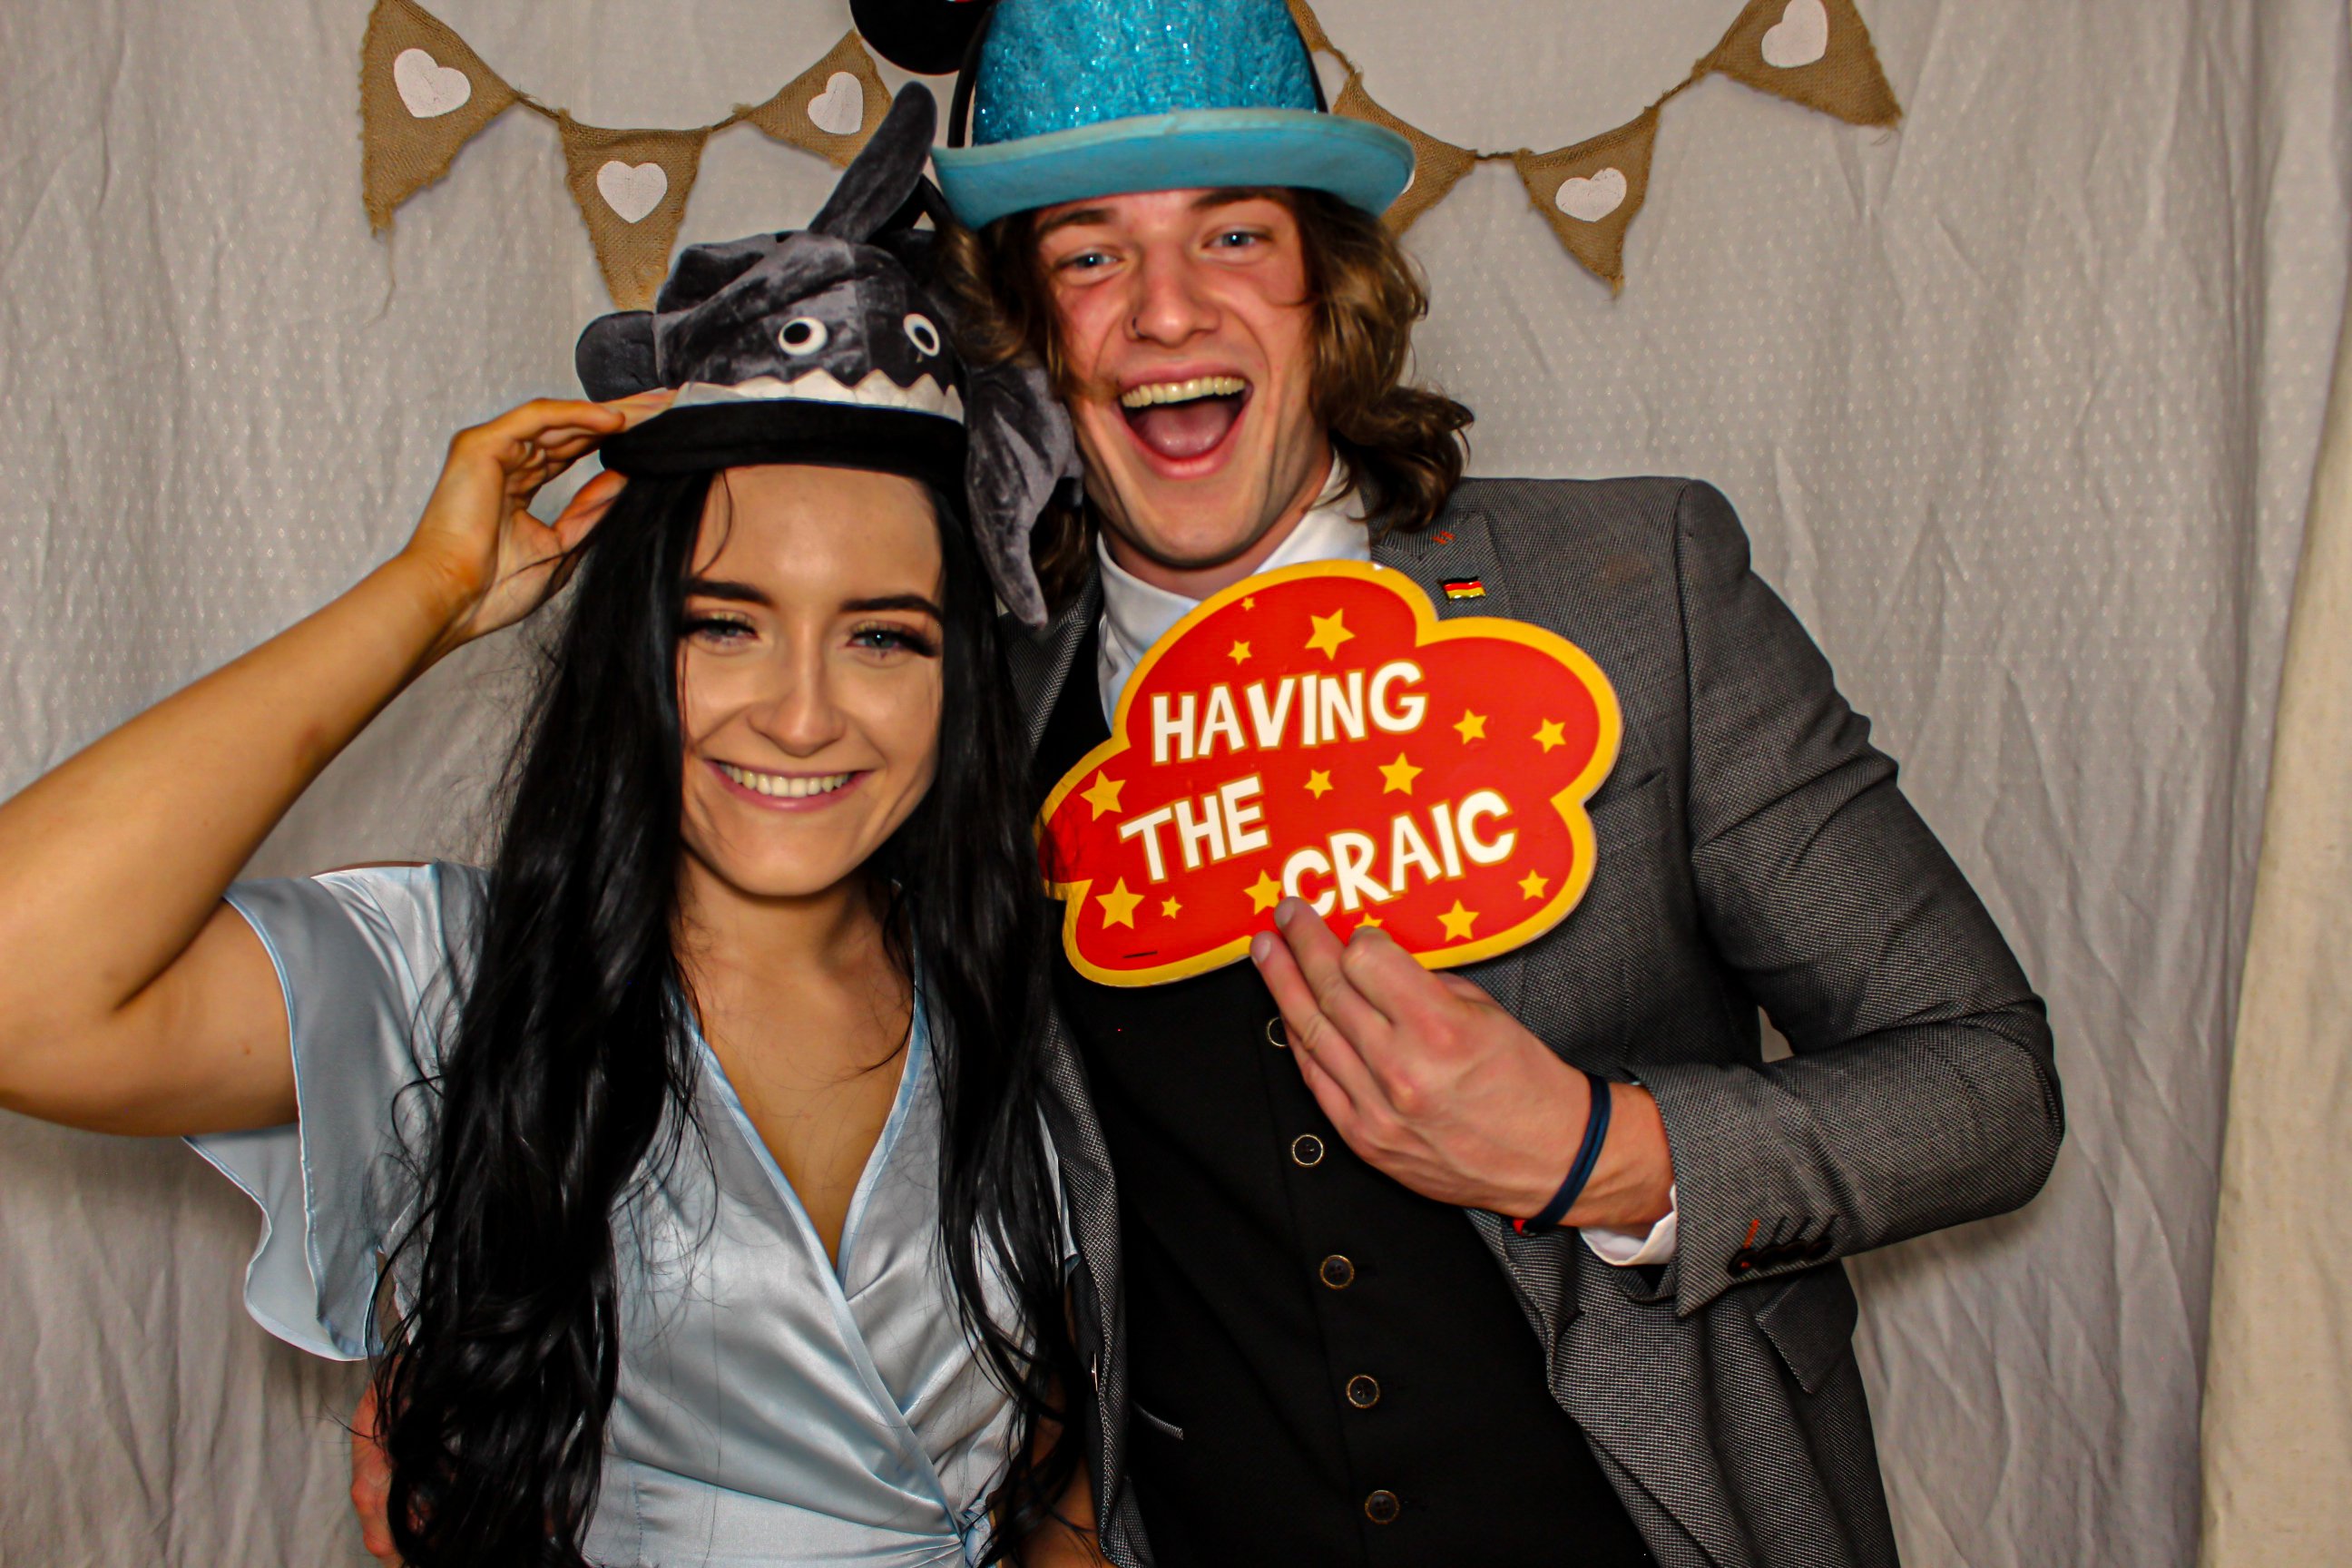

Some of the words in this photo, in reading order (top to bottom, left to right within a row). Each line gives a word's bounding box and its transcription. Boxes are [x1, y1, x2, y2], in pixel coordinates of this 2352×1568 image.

[1152, 661, 1427, 763] HAVING
[1120, 776, 1269, 882] THE
[1282, 790, 1515, 917] CRAIC
